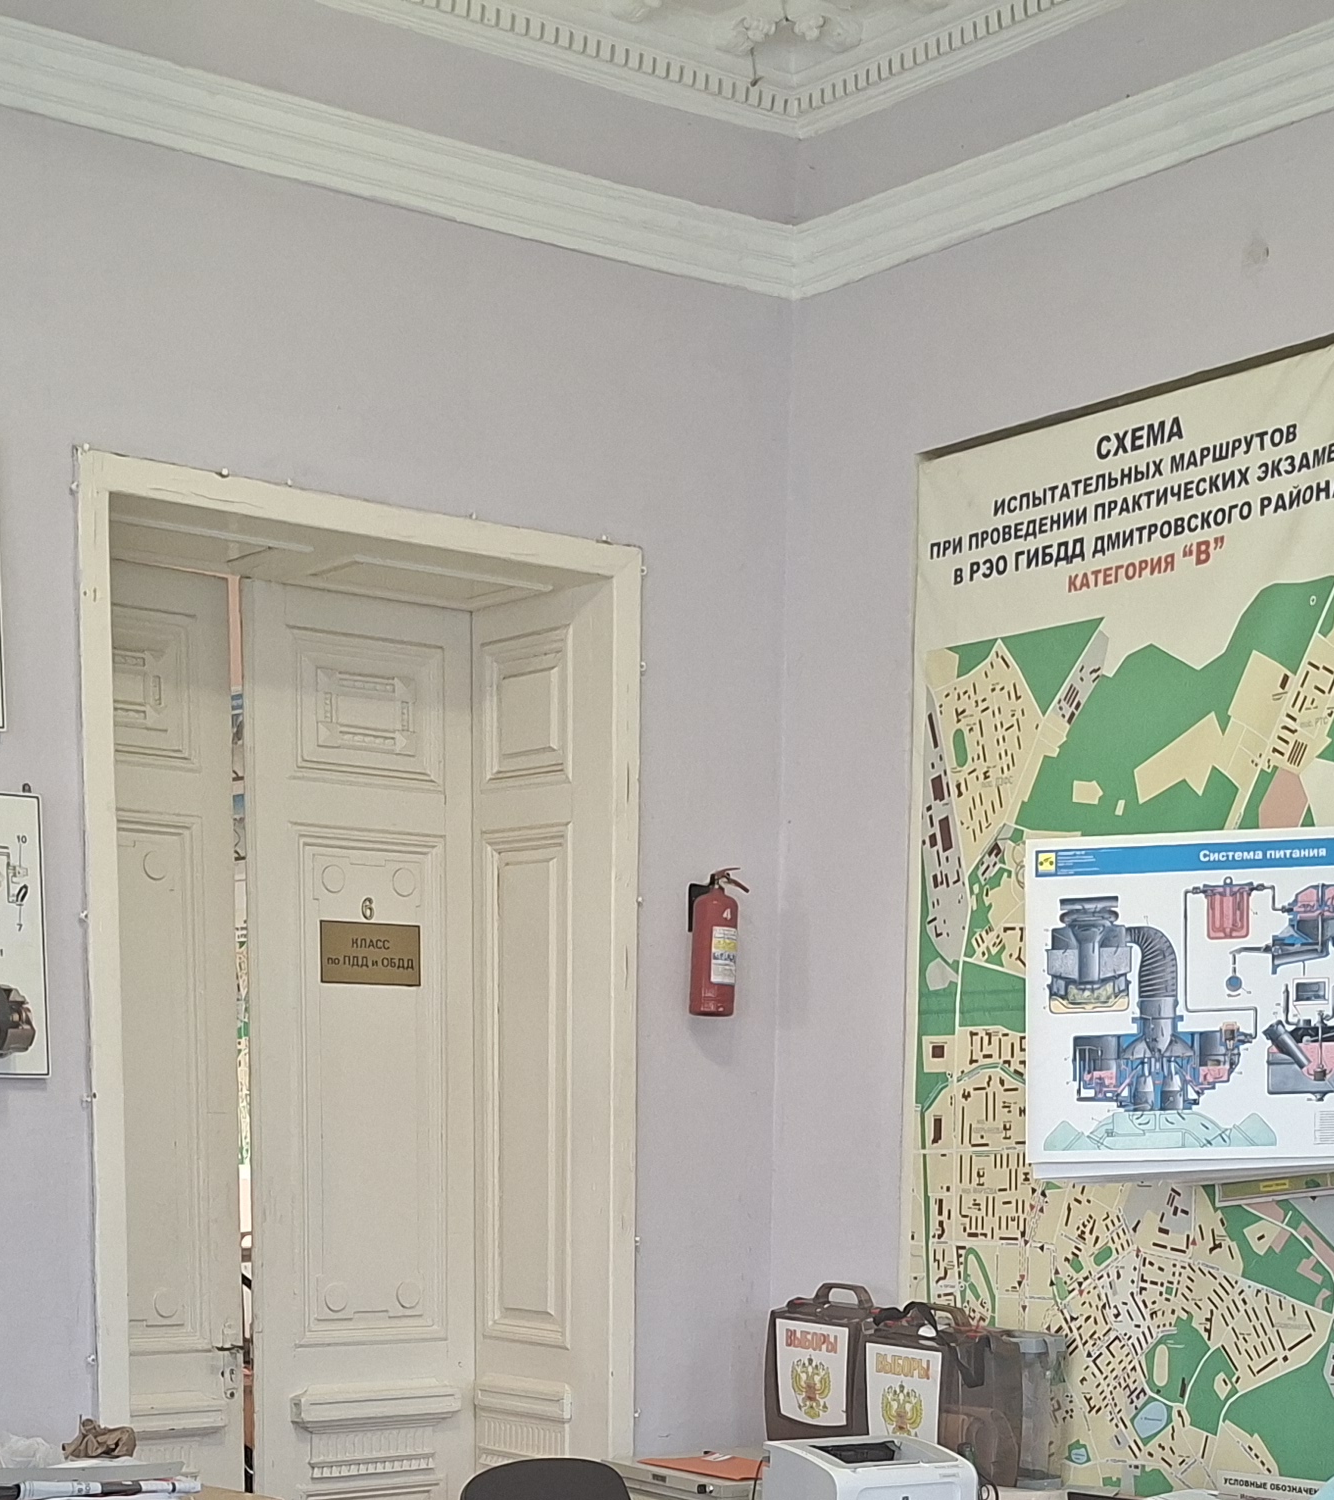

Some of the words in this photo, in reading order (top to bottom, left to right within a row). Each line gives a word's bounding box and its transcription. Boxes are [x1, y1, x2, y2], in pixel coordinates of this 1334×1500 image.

[1095, 415, 1184, 461] СХЕМА
[992, 457, 1165, 517] ИСПЫТАТЕЛЬНЫХ
[1169, 422, 1298, 476] МАРШРУТОВ
[929, 536, 963, 560] ПРИ
[967, 506, 1089, 552] ПРОВЕДЕНИИ
[1093, 467, 1251, 523] ПРАКТИЧЕСКИХ
[969, 555, 1008, 582] РЭО
[1014, 536, 1086, 573] ГИБДД
[1092, 502, 1253, 559] ДМИТРОВСКОГО
[1067, 552, 1177, 595] КАТЕГОРИЯ
[16, 835, 27, 844] 10
[1199, 847, 1262, 863] Система
[1266, 844, 1327, 862] питания
[361, 896, 375, 920] 6
[722, 907, 731, 920] 4
[17, 923, 23, 931] 7
[351, 937, 390, 950] КЛАСС
[327, 956, 340, 966] по
[343, 955, 369, 968] ПДД
[371, 959, 378, 967] и
[381, 957, 415, 971] ОБДД
[784, 1327, 839, 1355] ВЫБОРЫ
[874, 1351, 932, 1381] ВЫБОРЫ
[1223, 1476, 1268, 1490] УСЛОВНЫЕ
